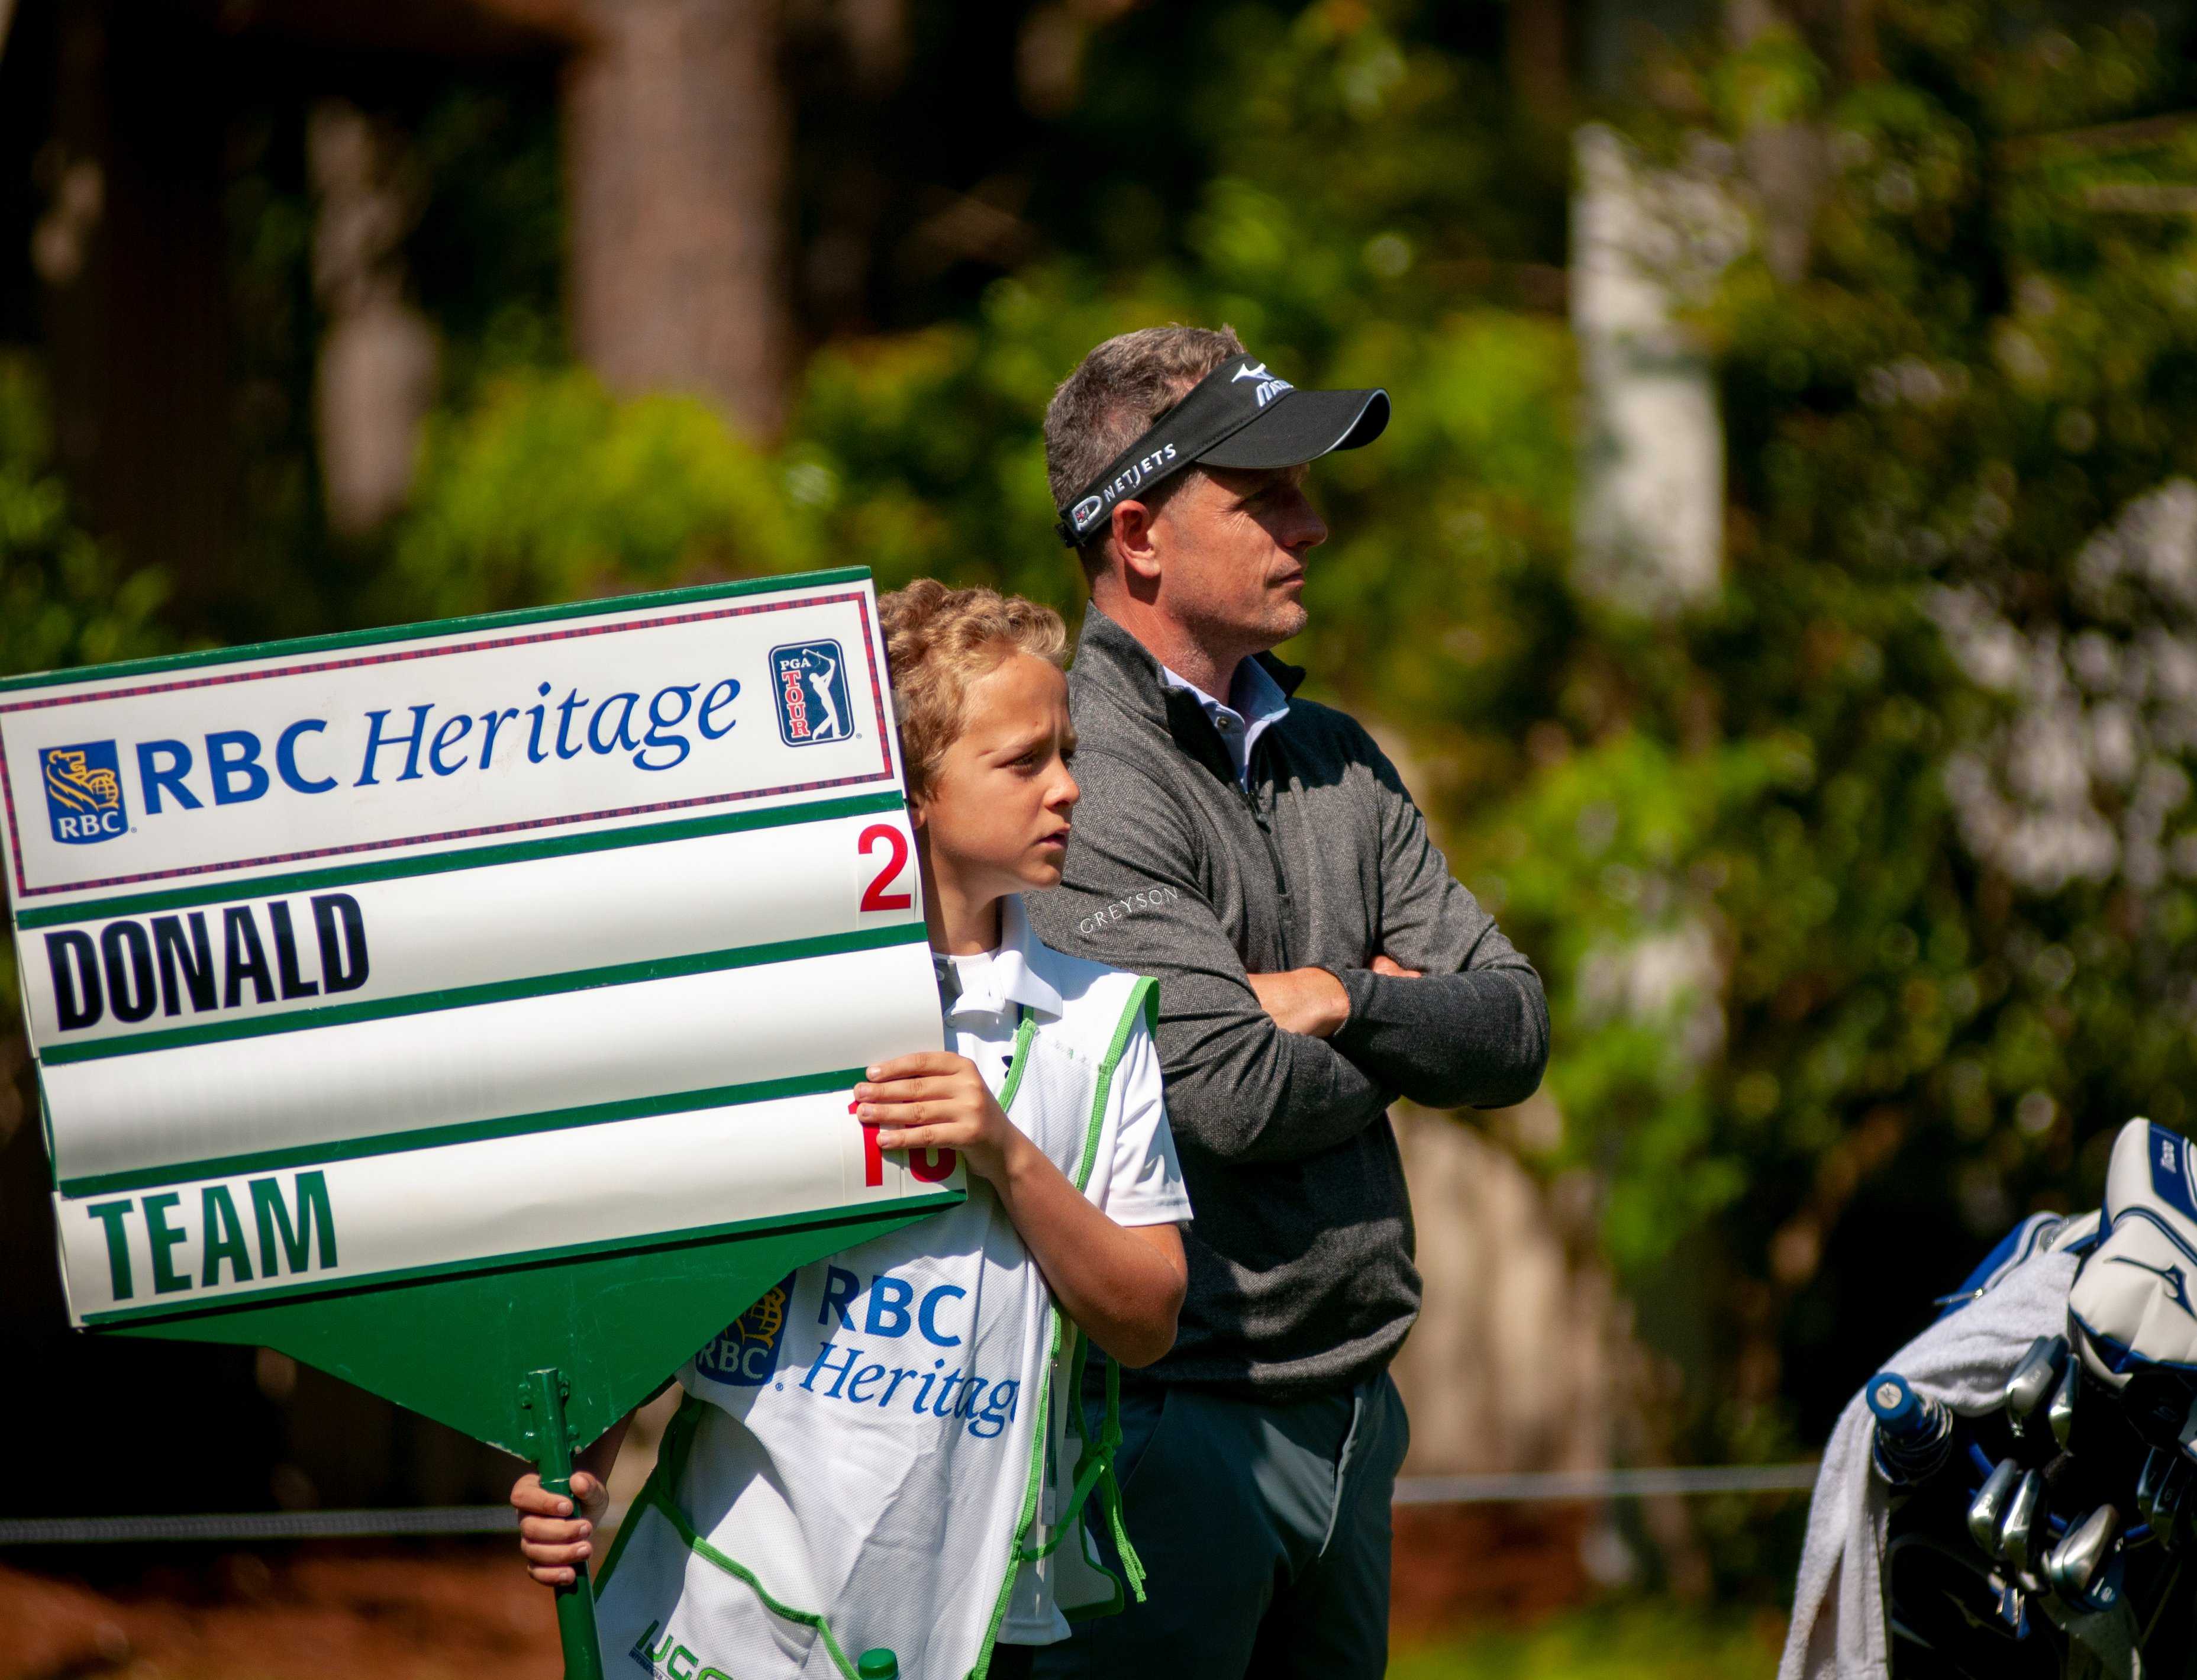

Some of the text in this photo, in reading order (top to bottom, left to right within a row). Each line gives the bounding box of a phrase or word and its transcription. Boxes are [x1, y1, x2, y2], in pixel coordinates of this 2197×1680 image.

[1104, 443, 1177, 502] NETJETS
[779, 657, 811, 670] PGA
[782, 670, 811, 738] TOUR
[136, 678, 741, 815] RBC Heritage
[58, 811, 122, 839] RBC
[44, 824, 912, 1032] DONALD 2
[1080, 886, 1178, 933] GREYSON
[86, 1169, 338, 1302] TEAM
[817, 1264, 967, 1347] RBC
